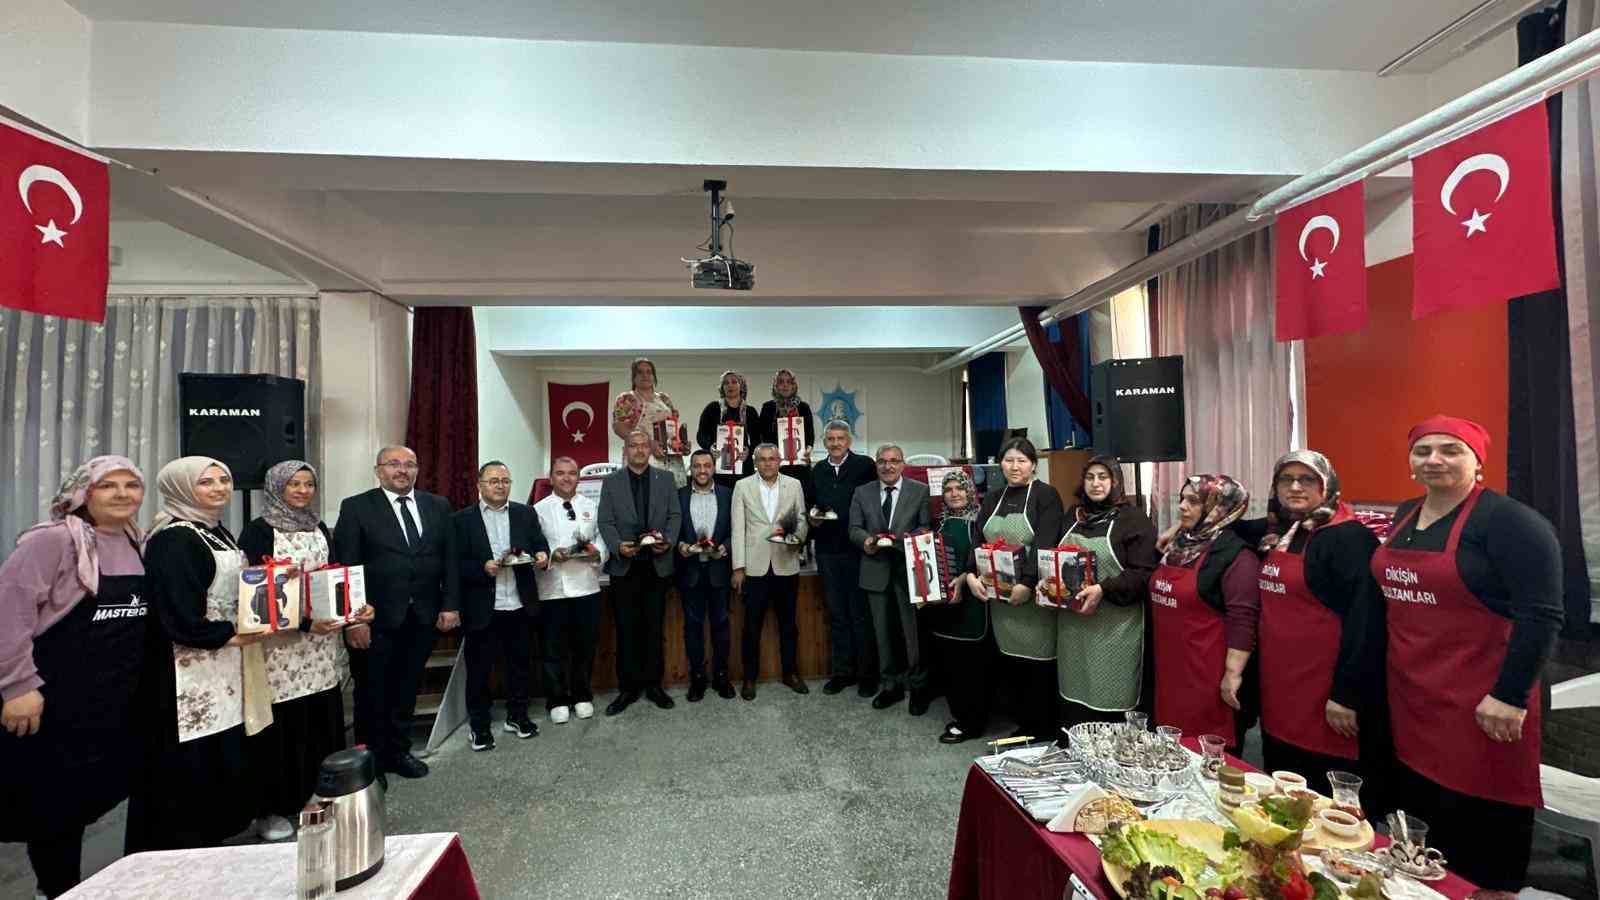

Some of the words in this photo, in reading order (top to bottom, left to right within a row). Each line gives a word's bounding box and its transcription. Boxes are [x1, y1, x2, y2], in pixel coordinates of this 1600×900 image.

[1115, 386, 1175, 397] KARAMAN
[189, 408, 261, 417] KARAMAN
[1385, 565, 1418, 586] DİKİŞİN
[92, 608, 139, 622] MASTER
